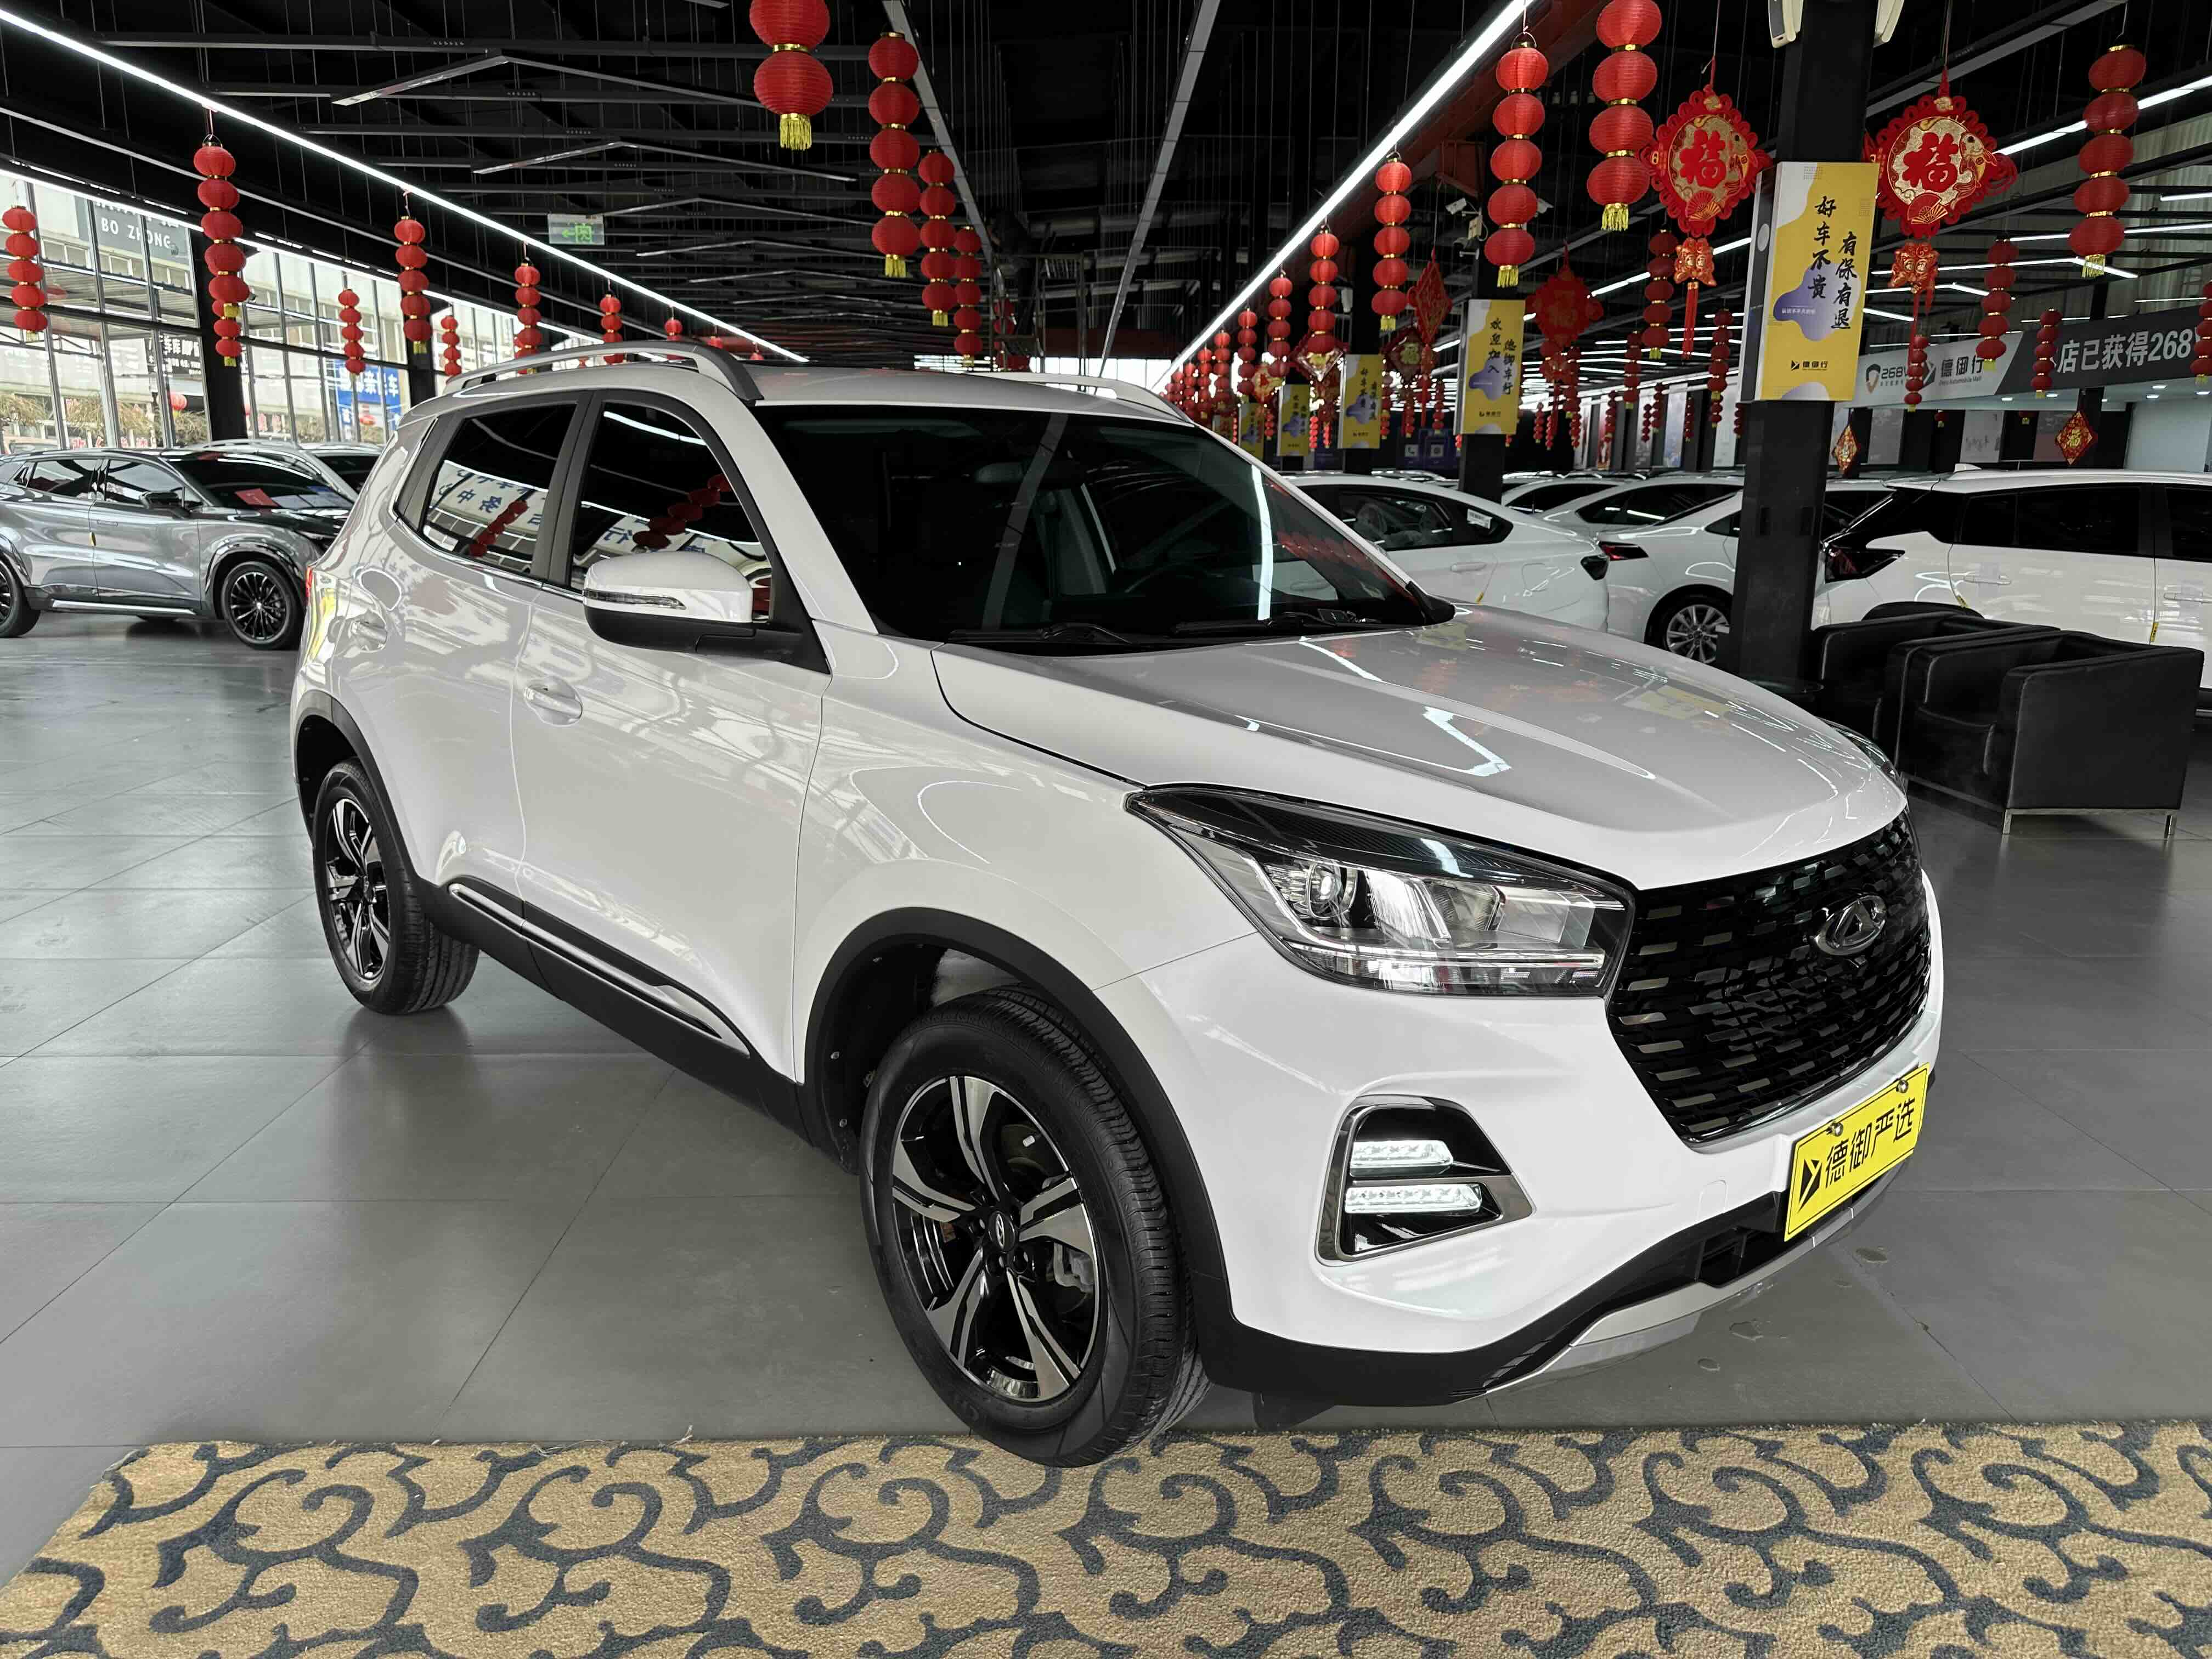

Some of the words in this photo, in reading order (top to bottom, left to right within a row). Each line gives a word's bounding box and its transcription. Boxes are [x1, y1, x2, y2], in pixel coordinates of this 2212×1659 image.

[1679, 129, 1726, 189] 福
[1902, 132, 1959, 192] 福
[101, 217, 119, 235] BO
[1808, 195, 1837, 300] 好车不贵
[1831, 231, 1858, 330] 有保有退
[1825, 1097, 1916, 1188] 德御严选
